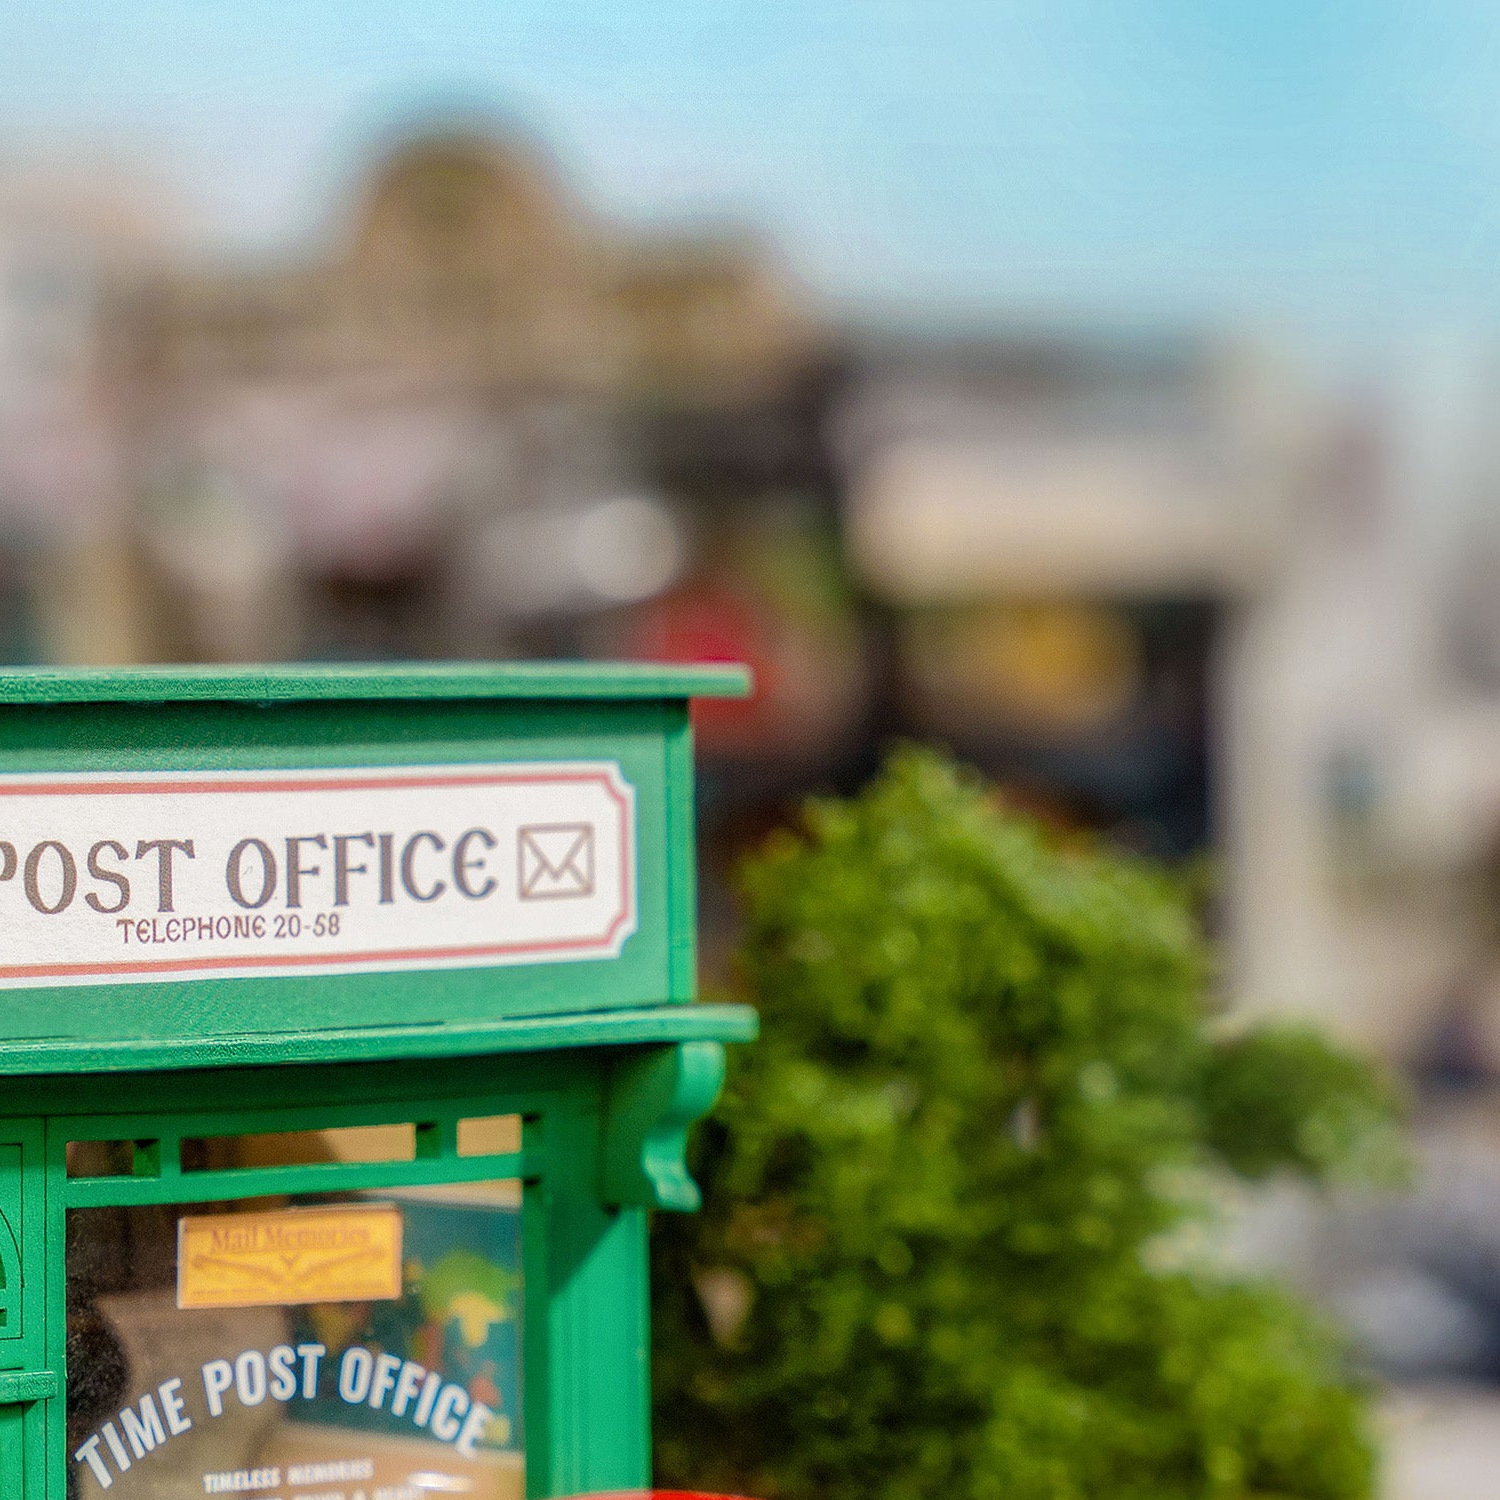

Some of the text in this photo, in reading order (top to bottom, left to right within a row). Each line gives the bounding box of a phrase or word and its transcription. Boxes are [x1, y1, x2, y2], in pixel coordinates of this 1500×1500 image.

[224, 826, 499, 910] OFFICE
[116, 911, 341, 945] TELEPHONE 20-58
[211, 1225, 258, 1252] Mail
[73, 1343, 495, 1489] TIME POST OFFICE
